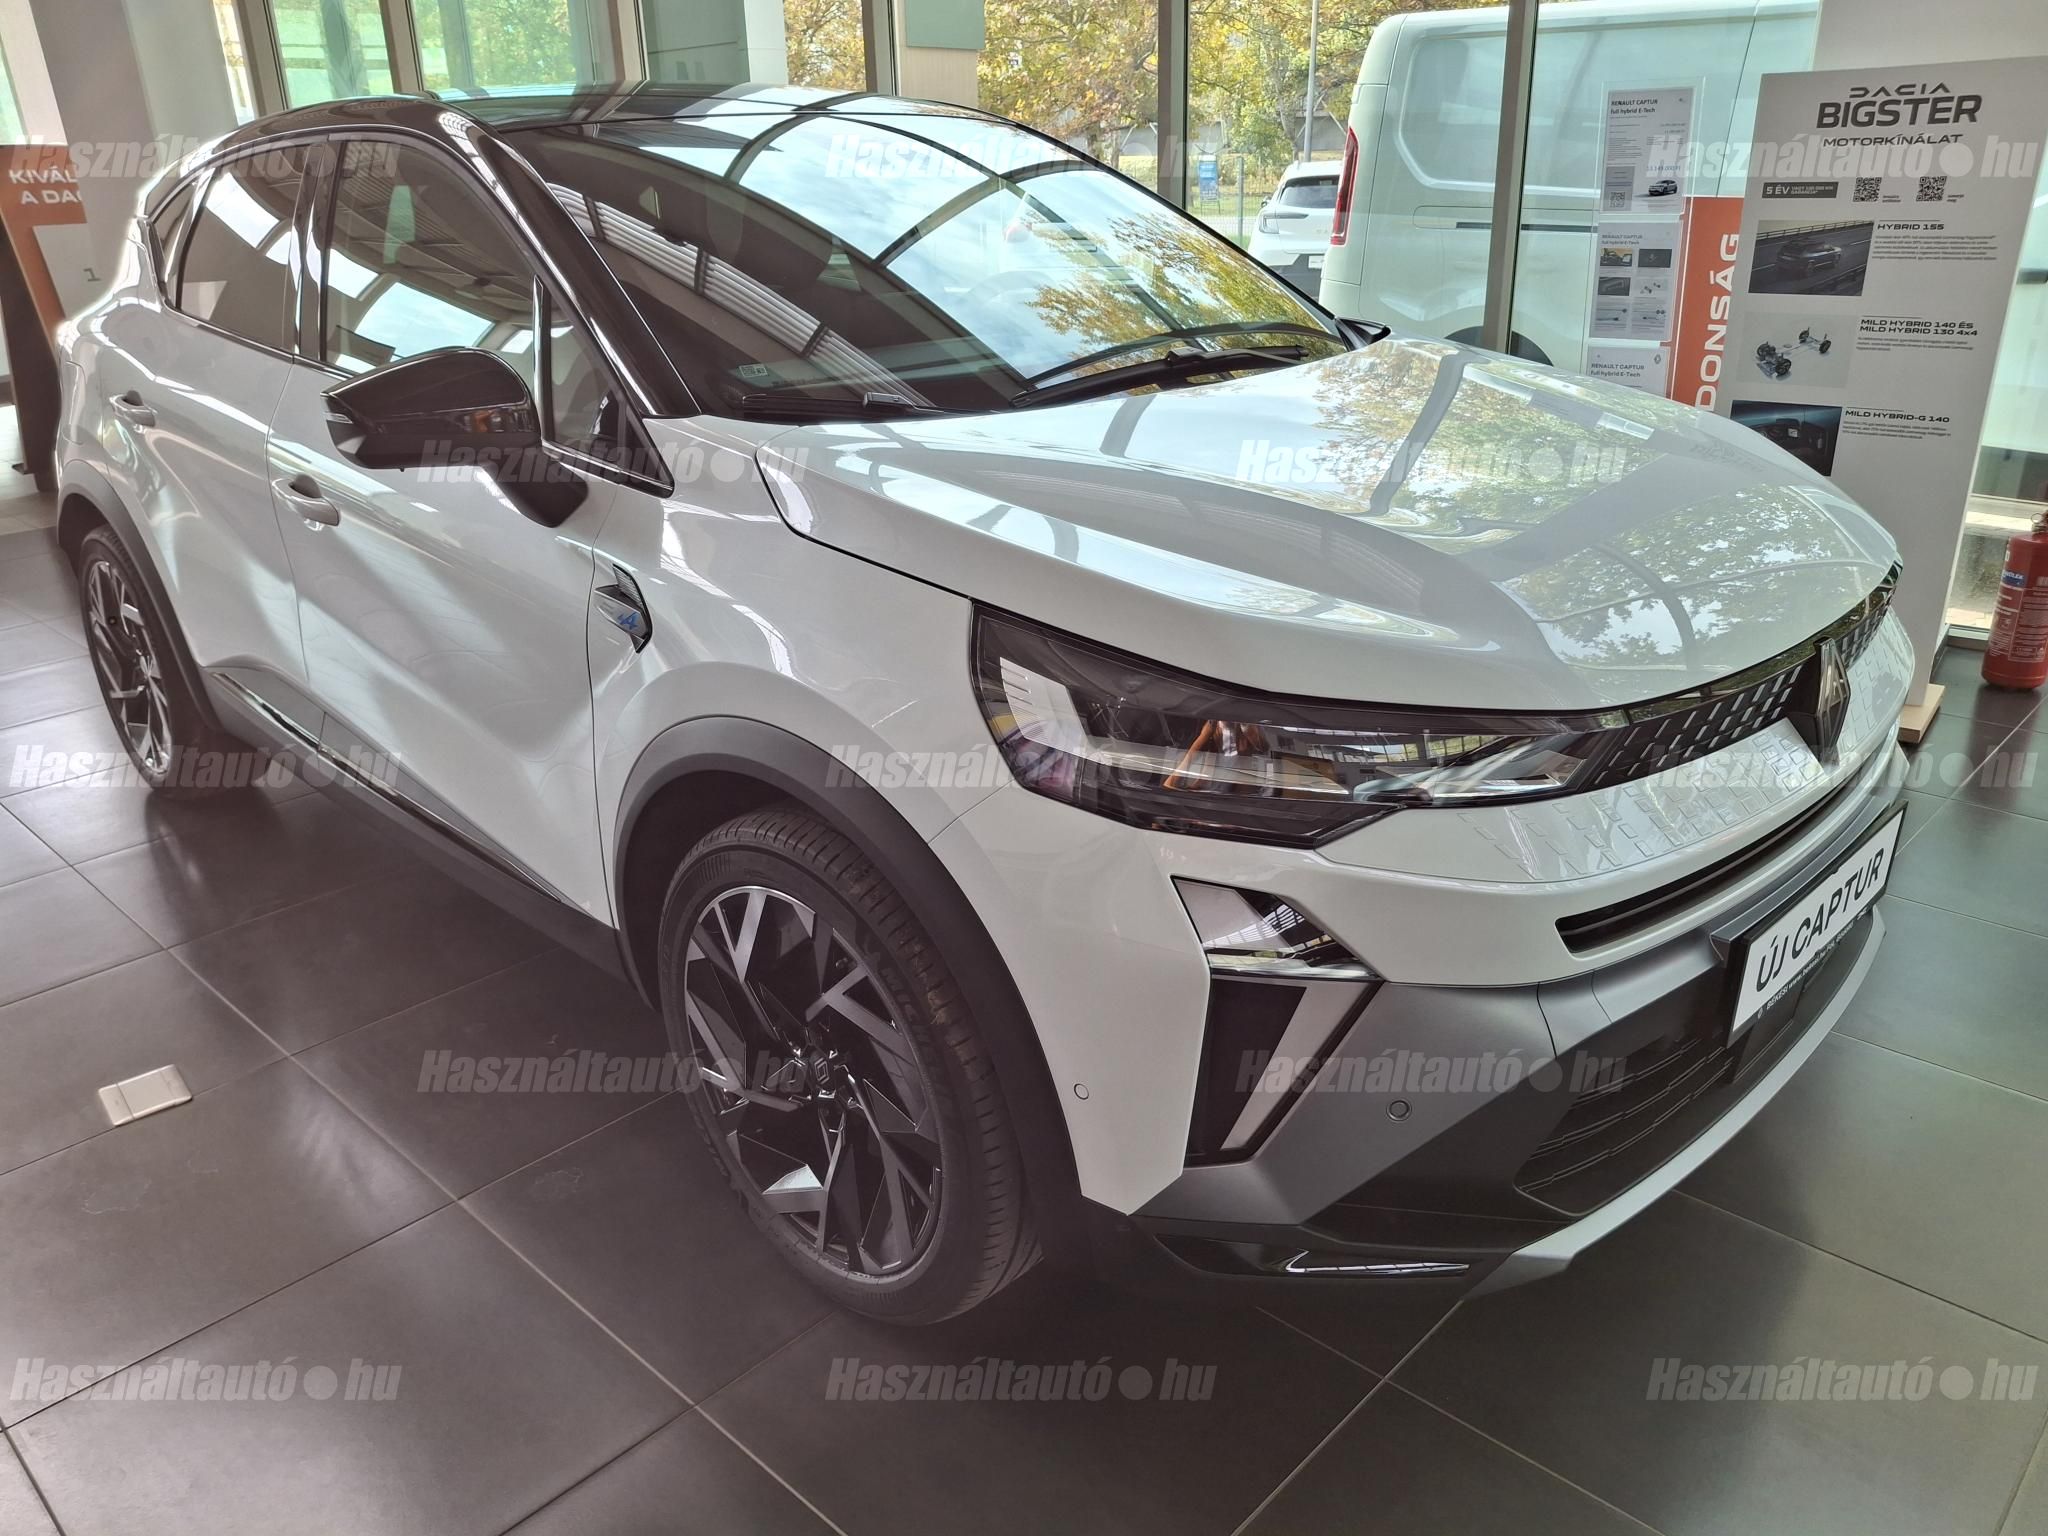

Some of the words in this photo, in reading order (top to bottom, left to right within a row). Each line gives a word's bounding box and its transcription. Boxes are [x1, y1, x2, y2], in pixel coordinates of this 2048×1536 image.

[1849, 82, 1951, 99] DACIA
[1816, 94, 1983, 129] BIGSTER
[1823, 132, 1964, 147] MOTORKÍNÁLAT
[1766, 186, 1773, 195] 5
[1775, 184, 1791, 195] ÉV
[21, 190, 39, 205] A
[1877, 223, 1921, 231] HYBRID
[1923, 223, 1945, 231] 155
[1859, 325, 1886, 333] MILD
[1888, 326, 1931, 335] HYBRID
[1889, 320, 1933, 328] HYBRID
[1933, 321, 1956, 329] 140
[1958, 320, 1975, 329] ÉS
[1845, 410, 1871, 418] MILD
[1872, 411, 1926, 422] HYBRID-G
[1926, 415, 1950, 423] 140
[1756, 934, 1789, 993] ÚJ
[1791, 847, 1885, 961] CAPTUR
